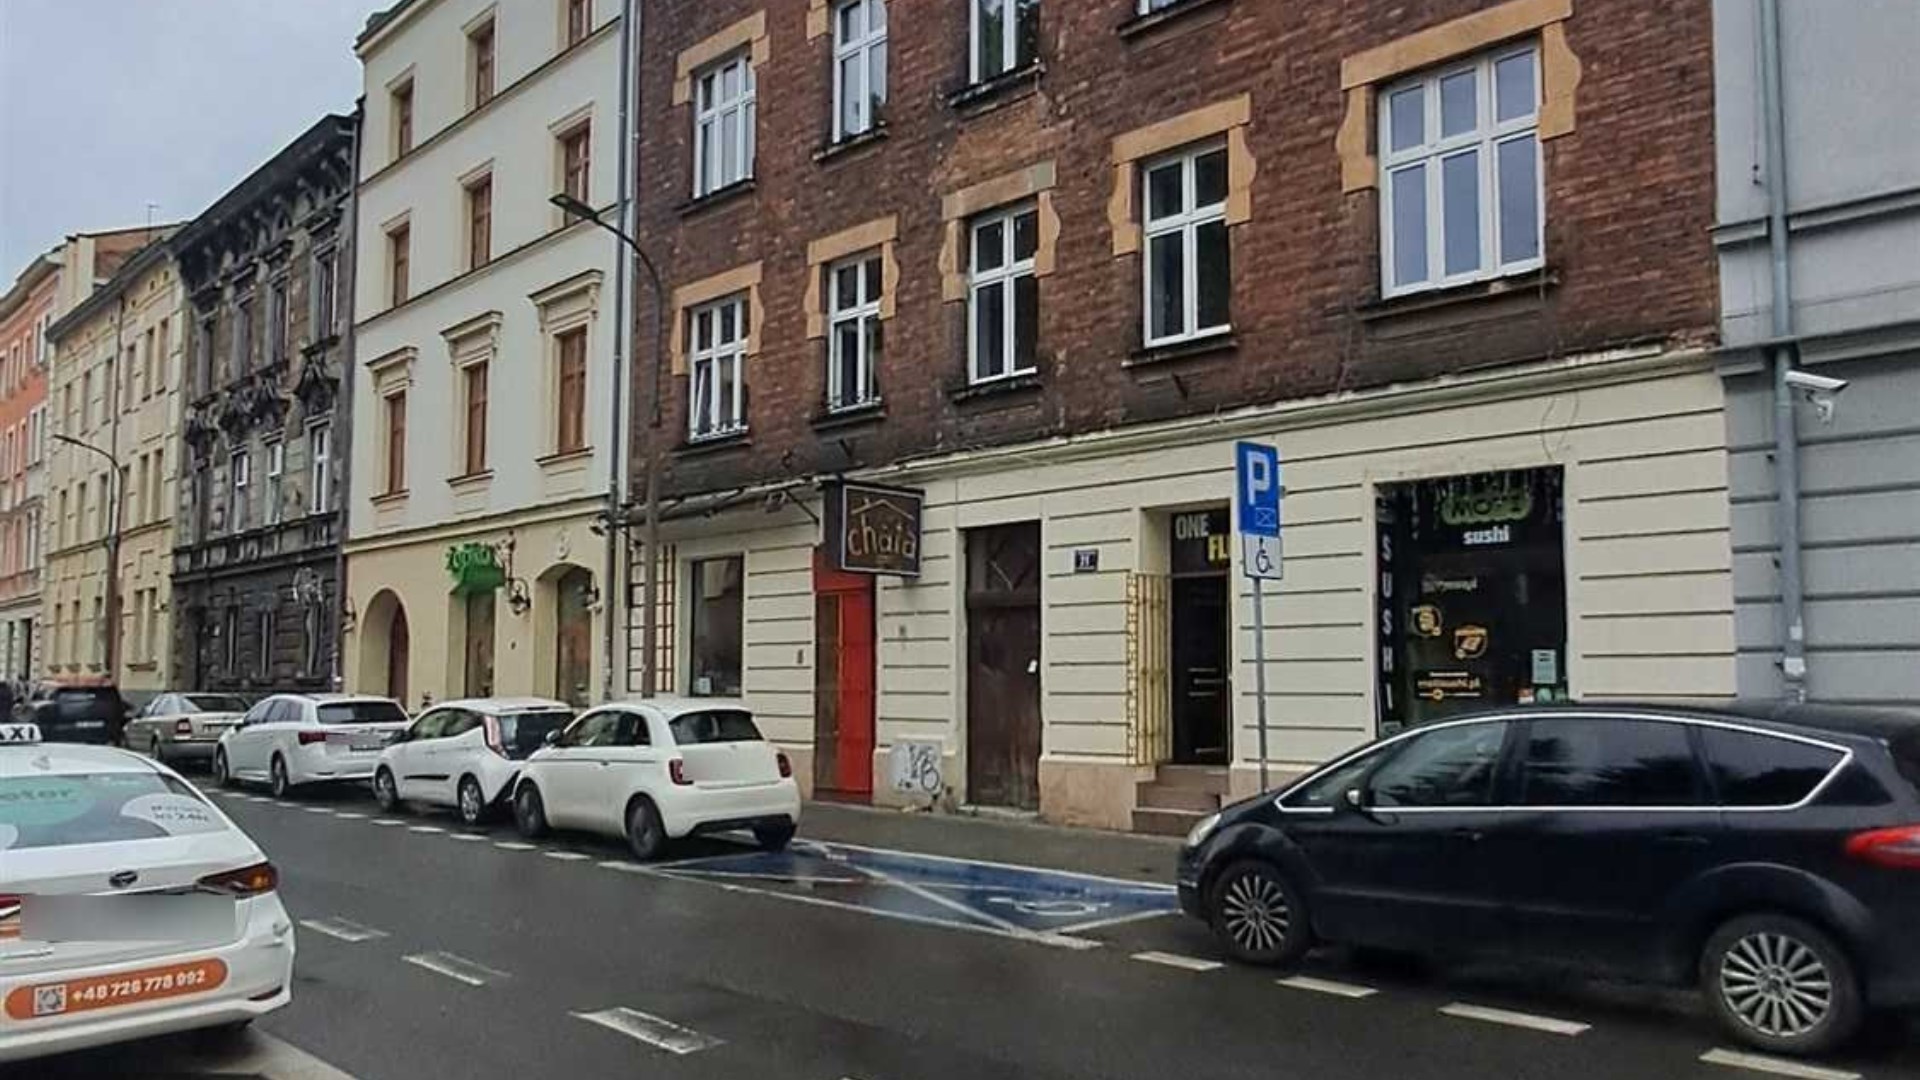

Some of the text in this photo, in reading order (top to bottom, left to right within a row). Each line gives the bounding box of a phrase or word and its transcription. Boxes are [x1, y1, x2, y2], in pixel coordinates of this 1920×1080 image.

[1246, 451, 1271, 505] P
[1175, 514, 1210, 540] ONE
[1463, 524, 1510, 545] sushi
[72, 985, 106, 1001] +48
